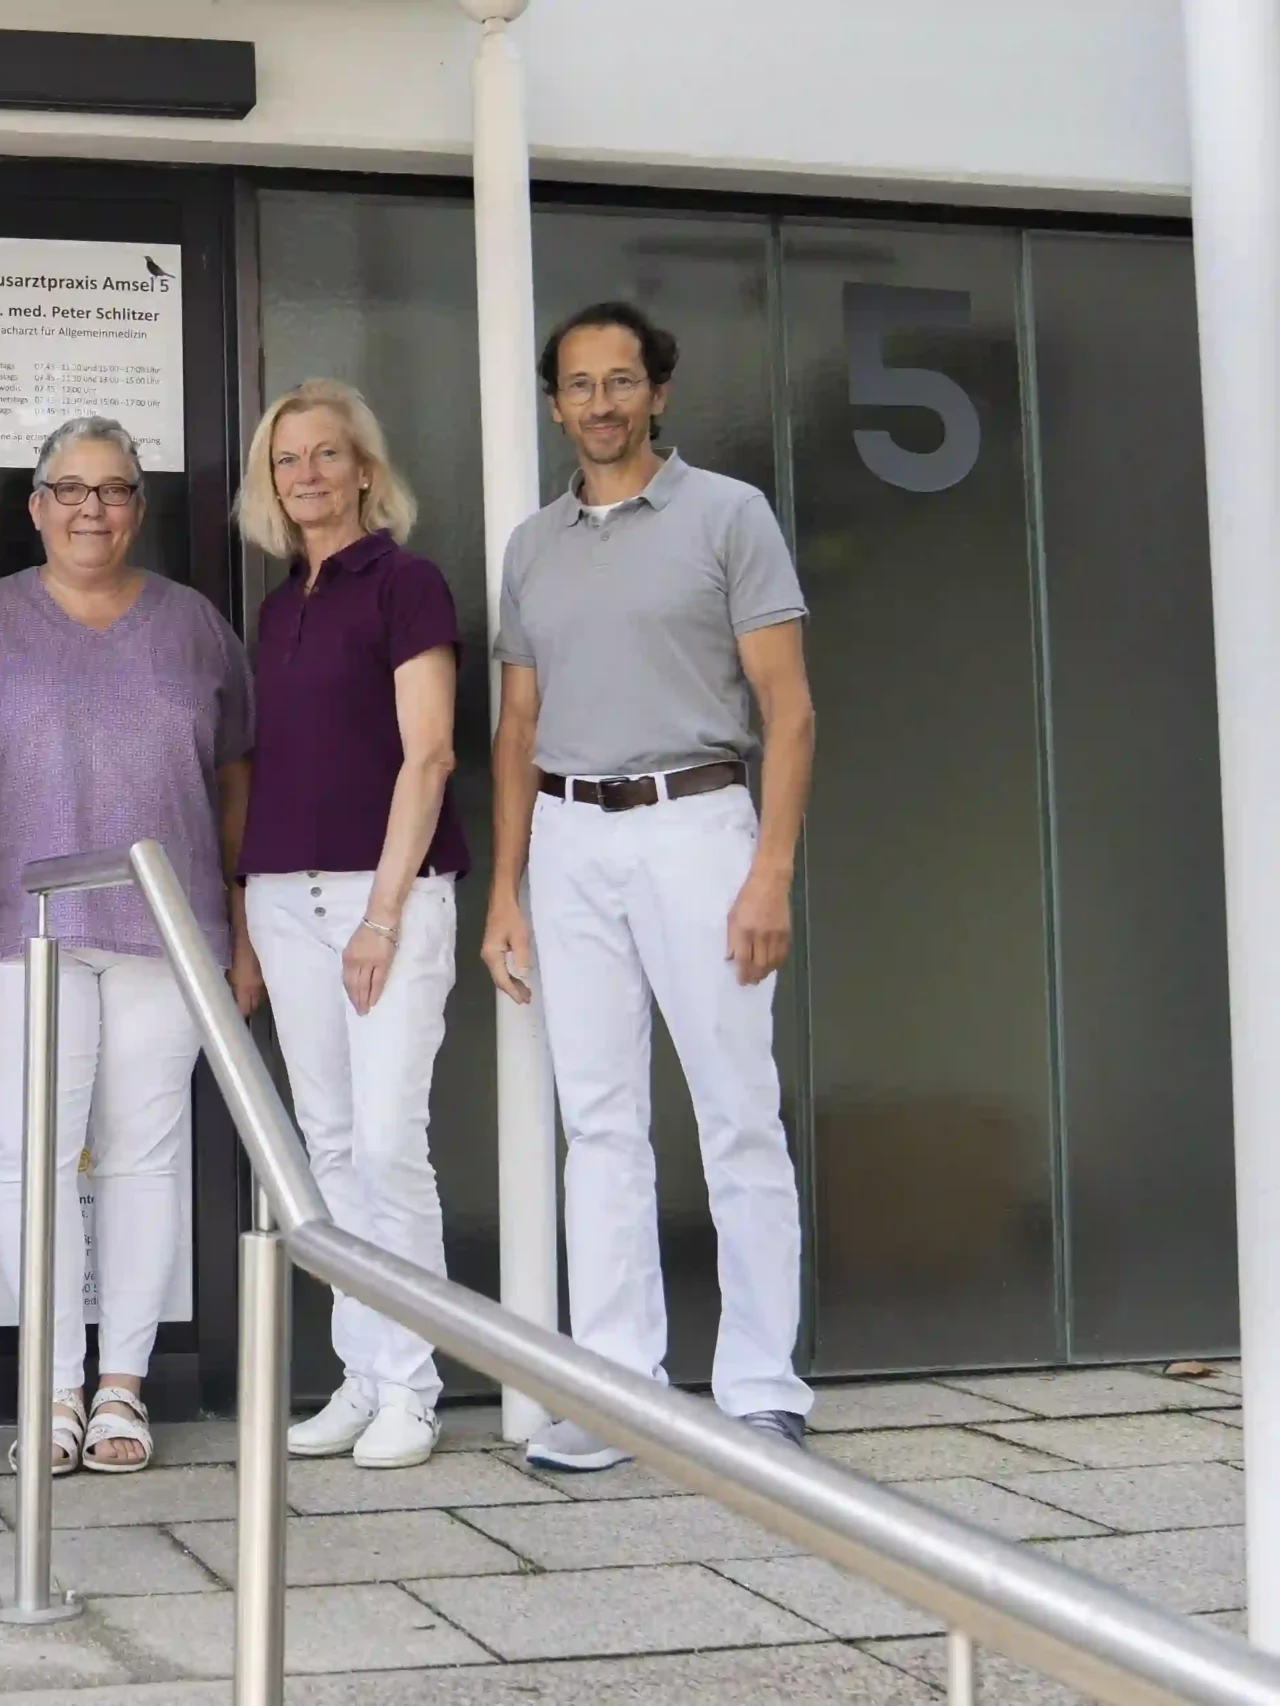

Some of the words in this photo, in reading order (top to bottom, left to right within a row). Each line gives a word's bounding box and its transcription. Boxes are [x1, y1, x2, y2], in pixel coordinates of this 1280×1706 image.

[102, 275, 155, 293] Amsel
[159, 278, 170, 293] 5
[8, 304, 47, 318] med.
[51, 305, 92, 320] Peter
[96, 307, 160, 322] Schlitzer
[40, 325, 56, 337] für
[58, 327, 148, 340] Allgemeinmedizin
[83, 363, 98, 372] und
[146, 365, 162, 374] Uhr
[843, 282, 981, 493] 5
[147, 399, 161, 408] Uhr
